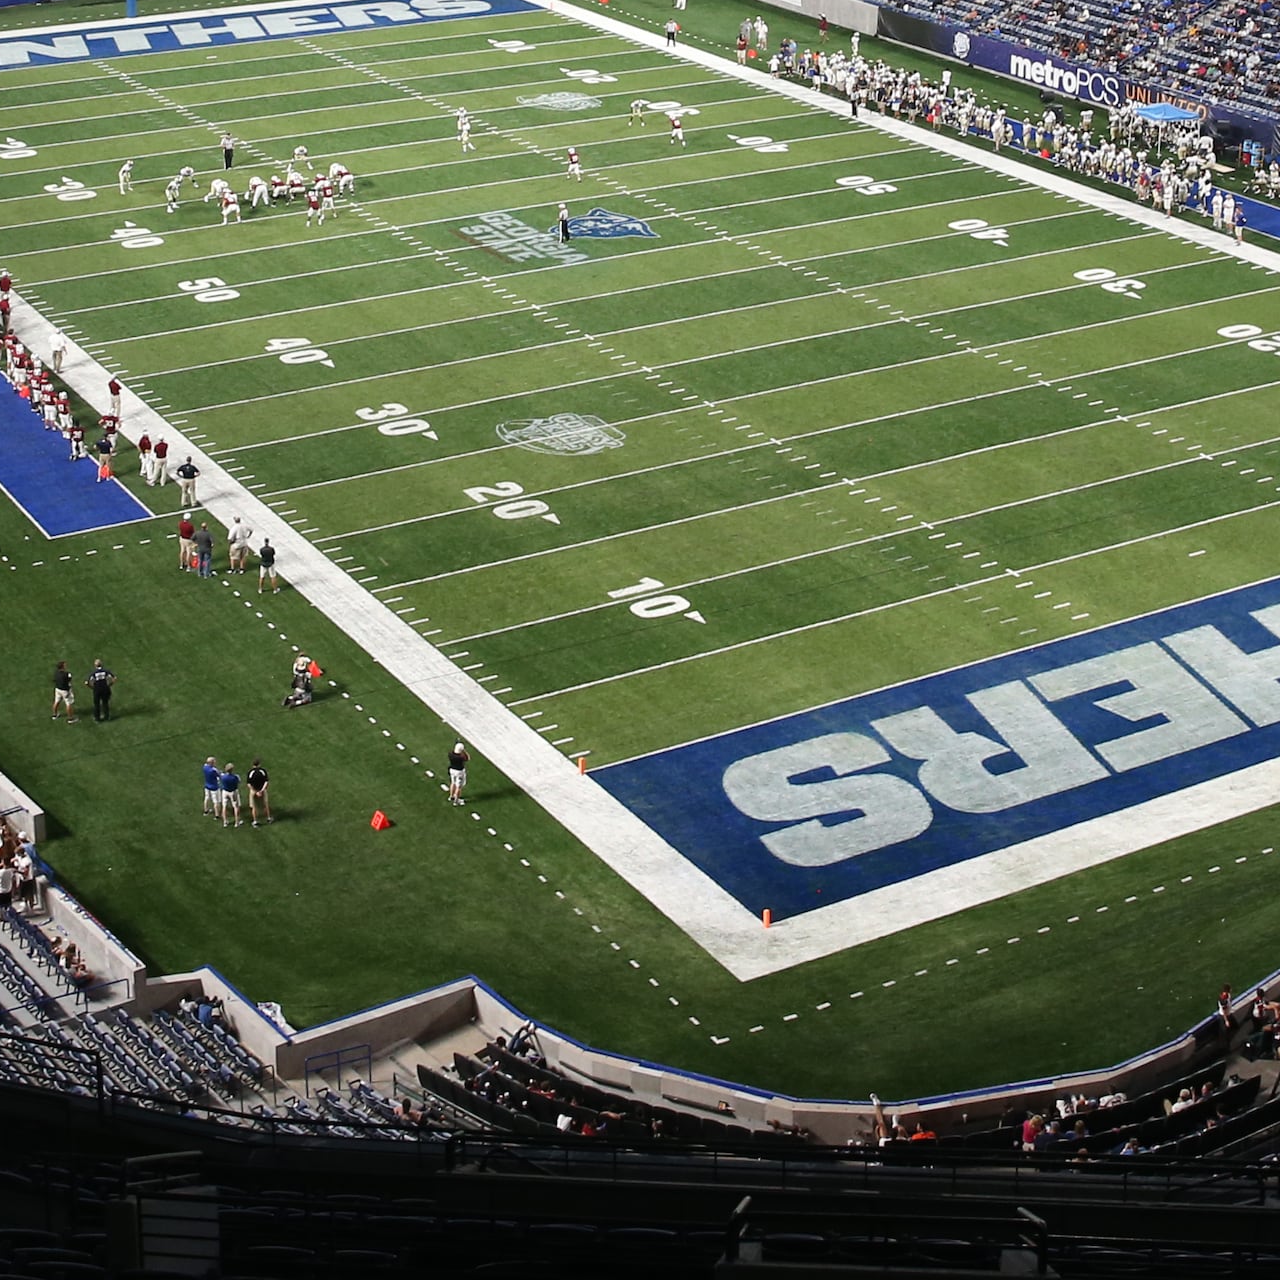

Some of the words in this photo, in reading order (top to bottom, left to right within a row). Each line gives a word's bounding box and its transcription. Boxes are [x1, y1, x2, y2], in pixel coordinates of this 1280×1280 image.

[566, 68, 618, 84] 20
[646, 100, 701, 118] 30
[735, 135, 790, 153] 40
[43, 180, 97, 201] 30
[835, 175, 898, 196] 50
[110, 228, 164, 249] 40
[479, 211, 590, 265] GEORGIA
[947, 218, 1009, 240] 40
[459, 225, 547, 263] STATE
[177, 276, 241, 304] 50
[1072, 268, 1147, 294] 30
[264, 337, 329, 365] 40
[354, 401, 431, 437] 30
[463, 481, 551, 520] 20
[607, 576, 692, 619] 10
